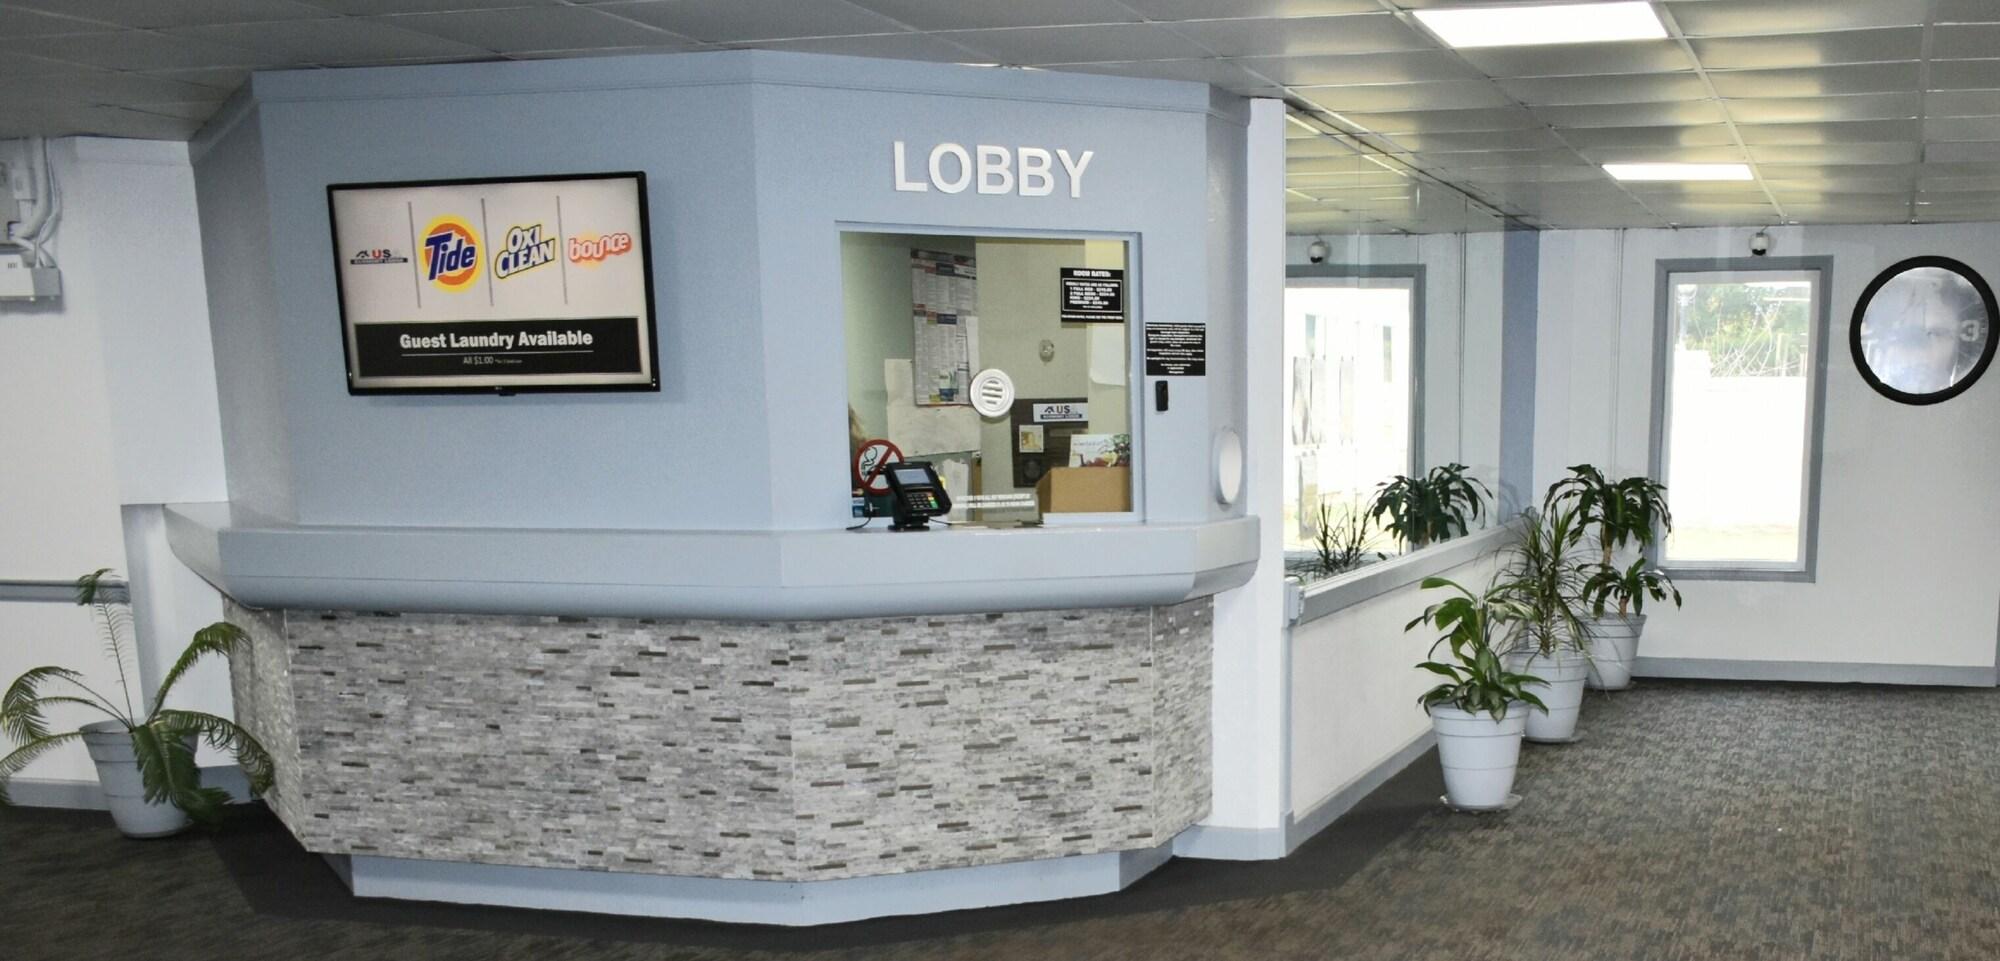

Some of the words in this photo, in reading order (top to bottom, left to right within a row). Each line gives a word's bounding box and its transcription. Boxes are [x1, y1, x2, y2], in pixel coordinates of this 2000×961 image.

[893, 140, 1094, 198] LOBBY
[506, 224, 541, 253] OXI
[568, 232, 632, 263] bounce
[424, 230, 477, 281] Tide
[495, 238, 555, 279] CLEAN
[400, 333, 447, 349] Guest
[449, 332, 514, 350] Laundry
[518, 330, 593, 346] Available
[474, 356, 494, 366] $1.00
[1056, 405, 1071, 414] US
